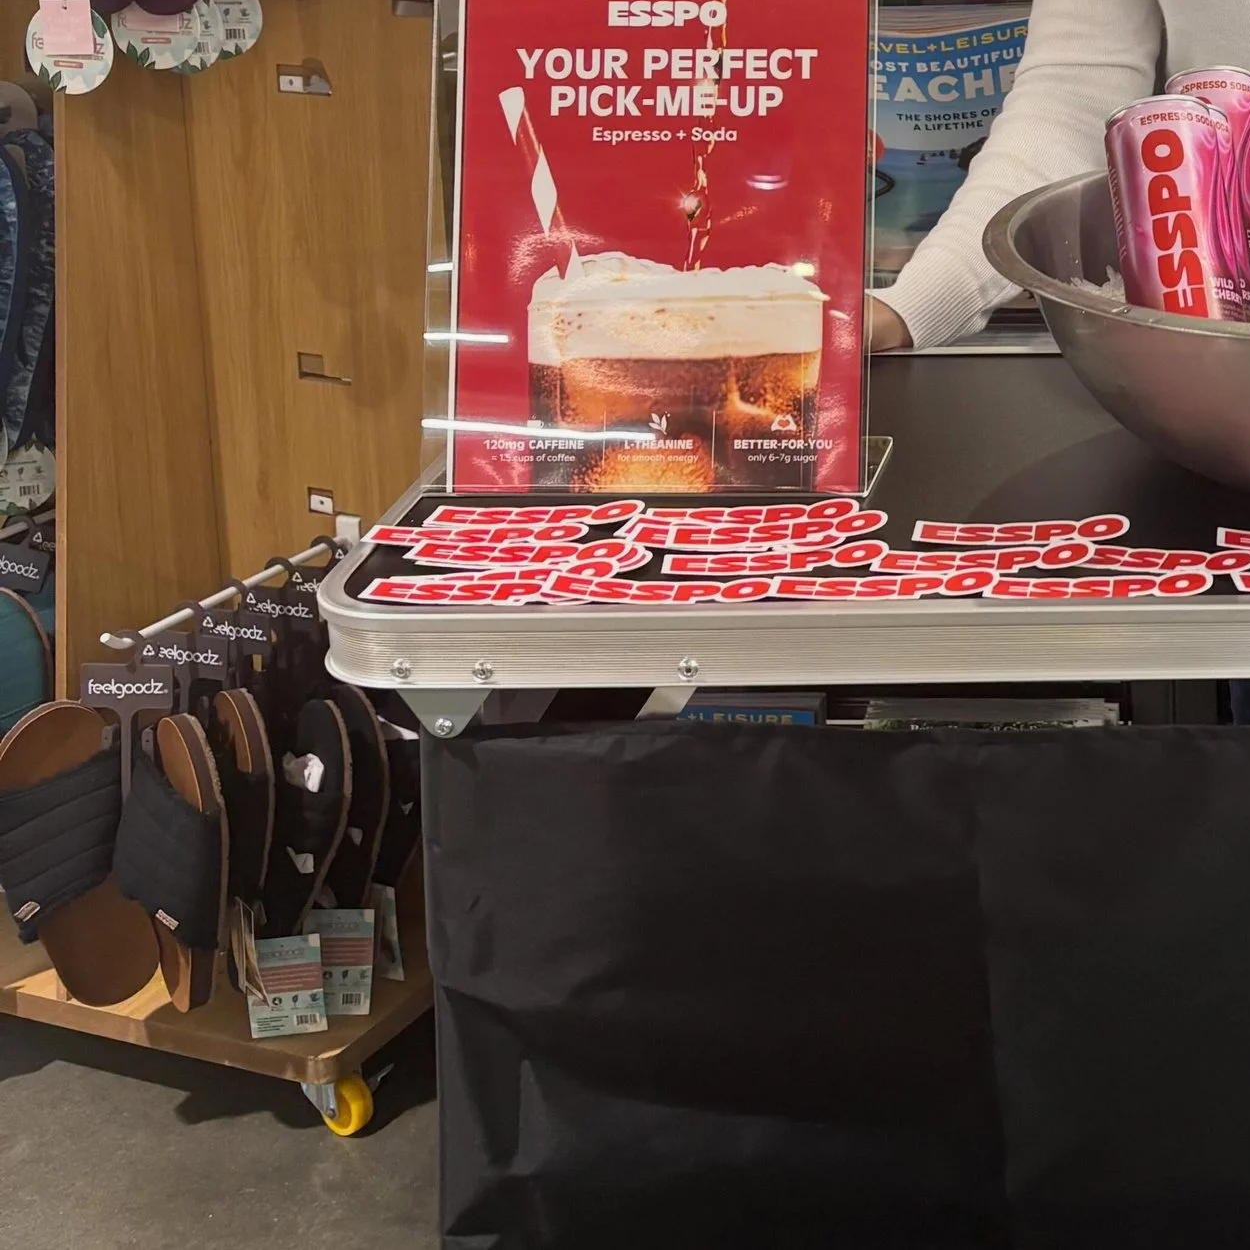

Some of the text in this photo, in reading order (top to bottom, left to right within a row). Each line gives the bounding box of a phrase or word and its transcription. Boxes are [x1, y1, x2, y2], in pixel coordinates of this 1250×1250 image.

[607, 0, 728, 27] ESSPO
[516, 47, 818, 81] YOUR PERFECT
[549, 85, 785, 117] PICK-ME-UP
[896, 108, 997, 122] THE SHORES OF
[1140, 111, 1194, 126] ESPRESSO
[592, 126, 737, 145] Espresso Soda
[913, 120, 984, 131] A LIFETIME
[1211, 276, 1234, 290] WILD
[483, 439, 584, 452] 120mg CAFFEINE
[624, 439, 694, 450] L-THEANINE
[733, 439, 833, 450] BETTER-FOR-YOU
[536, 453, 576, 462] of coffee
[631, 453, 699, 464] smooth energy
[747, 454, 818, 464] only sugar
[434, 502, 641, 525] ESSPO
[919, 517, 1125, 543] ESSPO
[669, 542, 884, 572] ESSPO
[878, 542, 1090, 571] ESSPO
[552, 574, 771, 602] ESSPO
[776, 570, 994, 599] ESSPO
[990, 572, 1209, 598] ESSPO
[88, 678, 164, 699] feelgoodz
